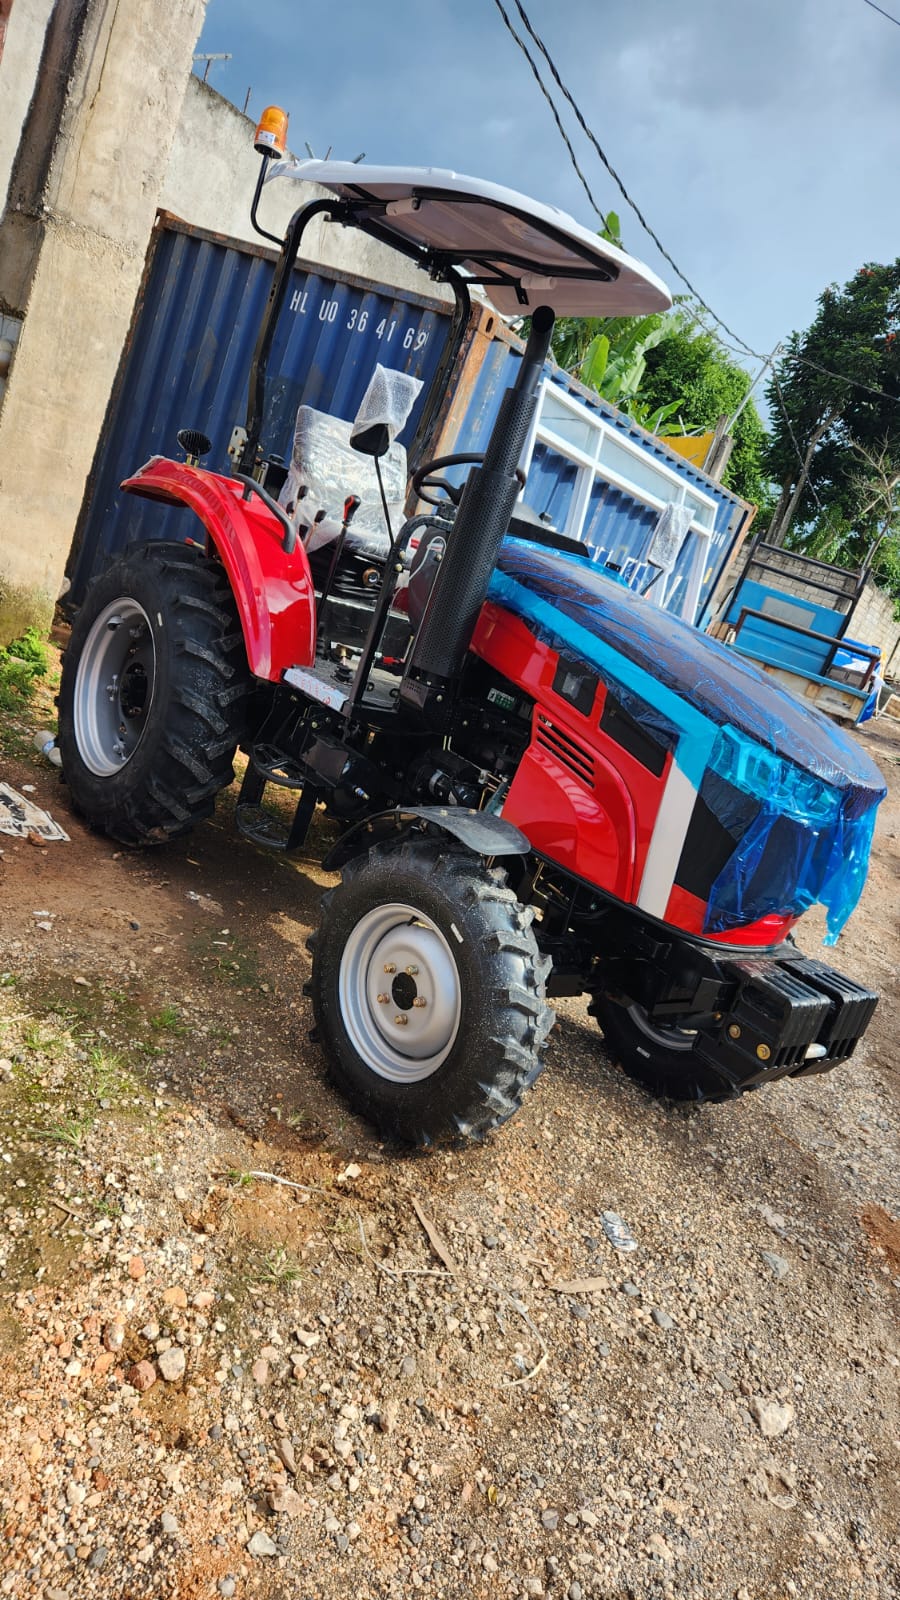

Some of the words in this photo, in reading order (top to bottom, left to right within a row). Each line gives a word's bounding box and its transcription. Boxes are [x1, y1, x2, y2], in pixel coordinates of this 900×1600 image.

[289, 290, 308, 314] HL
[346, 309, 369, 332] 36
[375, 318, 397, 342] 41
